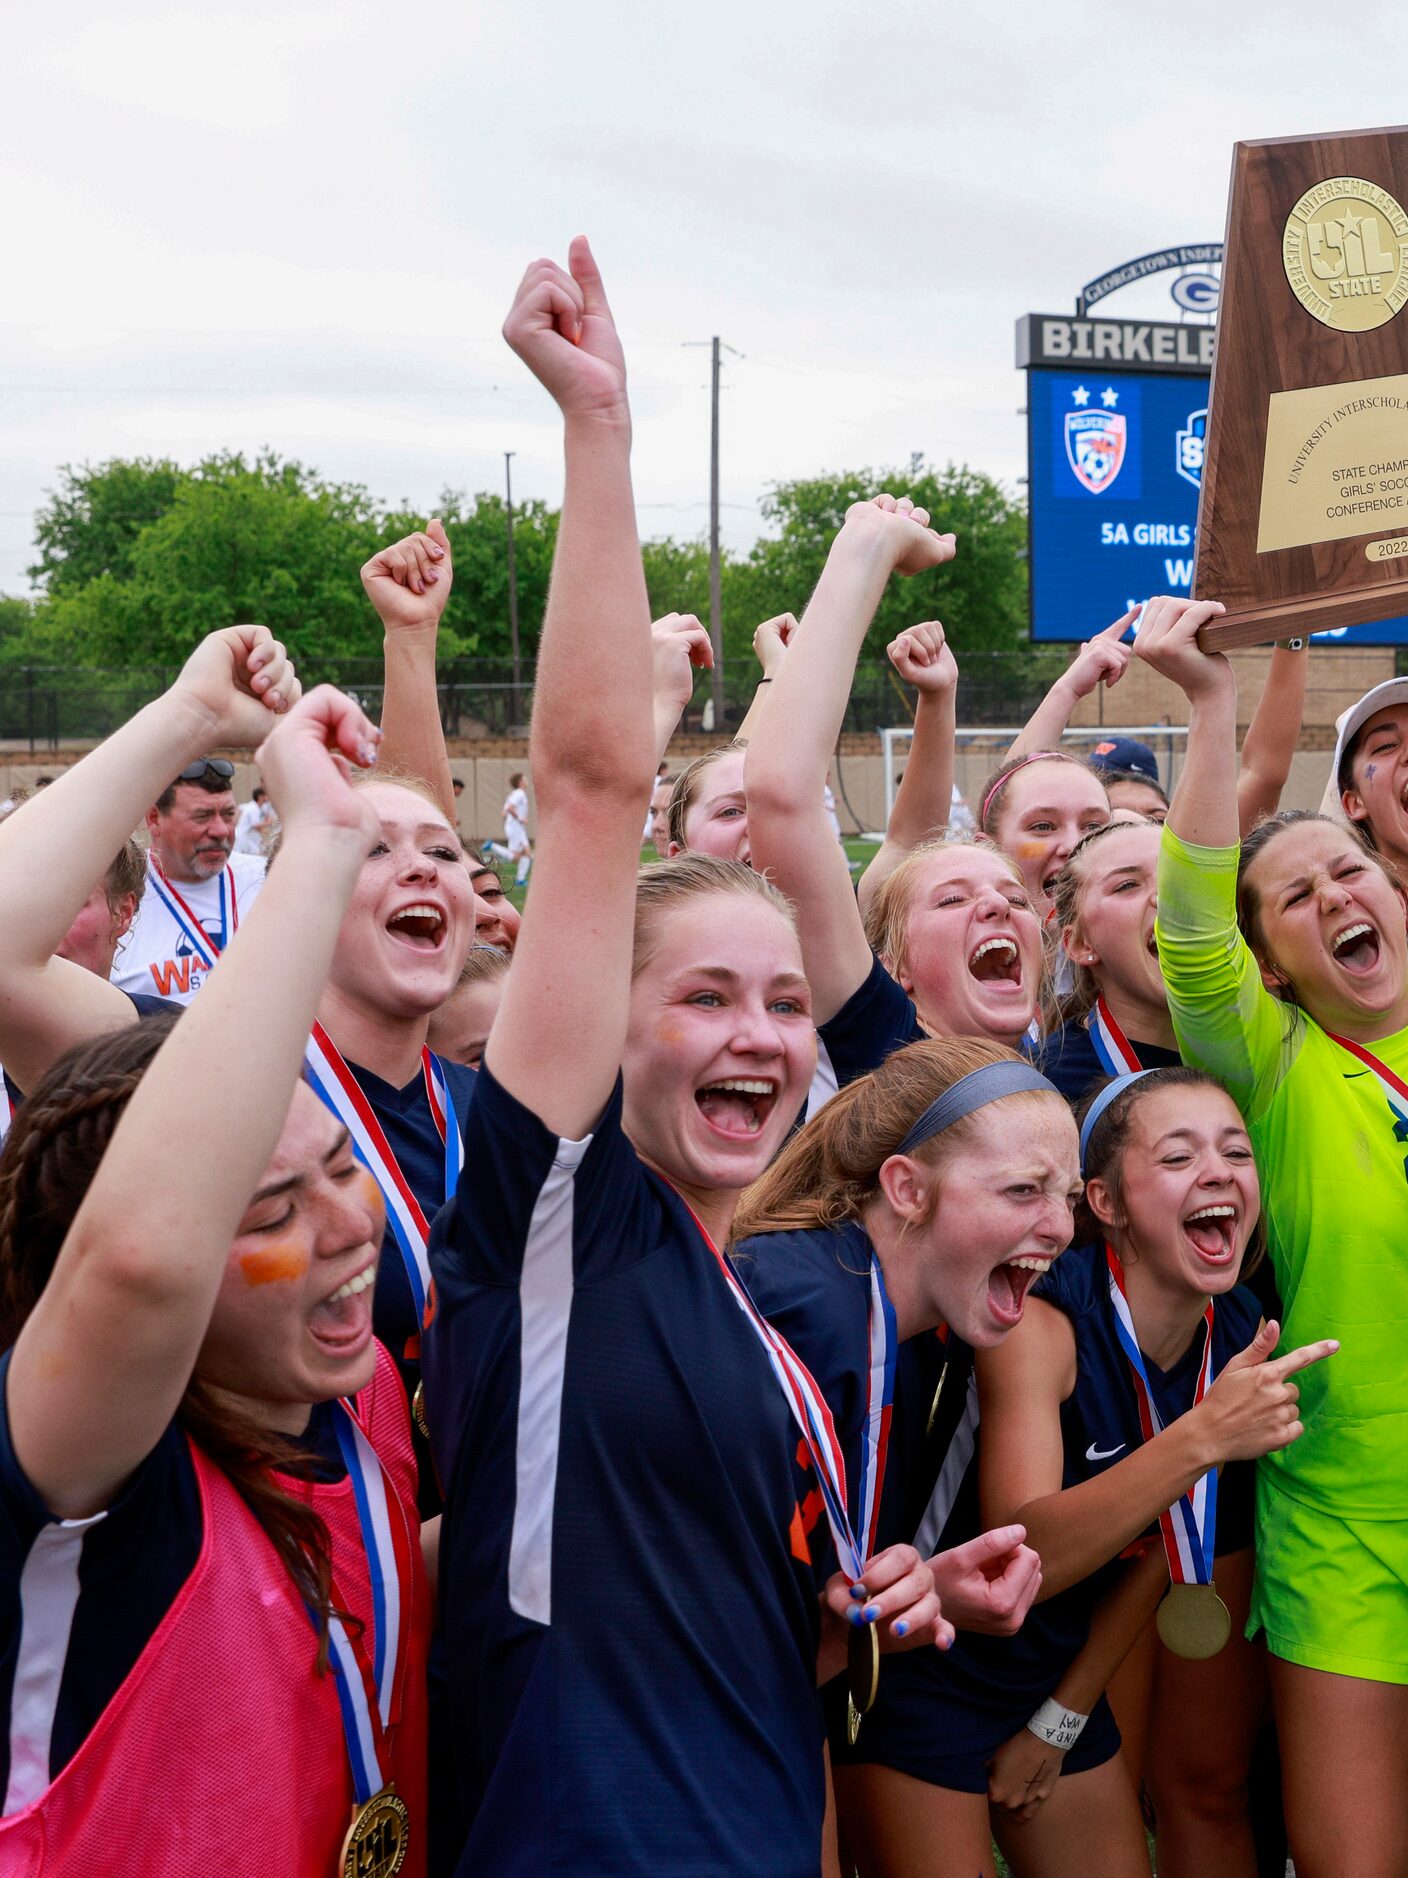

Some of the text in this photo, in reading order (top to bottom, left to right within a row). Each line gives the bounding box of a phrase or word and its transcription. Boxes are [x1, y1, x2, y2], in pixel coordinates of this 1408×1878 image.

[1085, 250, 1178, 303] GEORGETOWN
[1286, 227, 1331, 319] UNIVERSITY
[1328, 276, 1382, 299] STATE
[1288, 417, 1333, 485] UNIVERSITY
[1332, 466, 1366, 482] STATE
[1326, 496, 1403, 518] CONFERENCE
[1101, 523, 1129, 544] 5A
[1133, 523, 1190, 545] GIRLS
[1378, 540, 1408, 556] 2022
[1059, 1713, 1080, 1729] WAY
[1046, 1728, 1056, 1739] A
